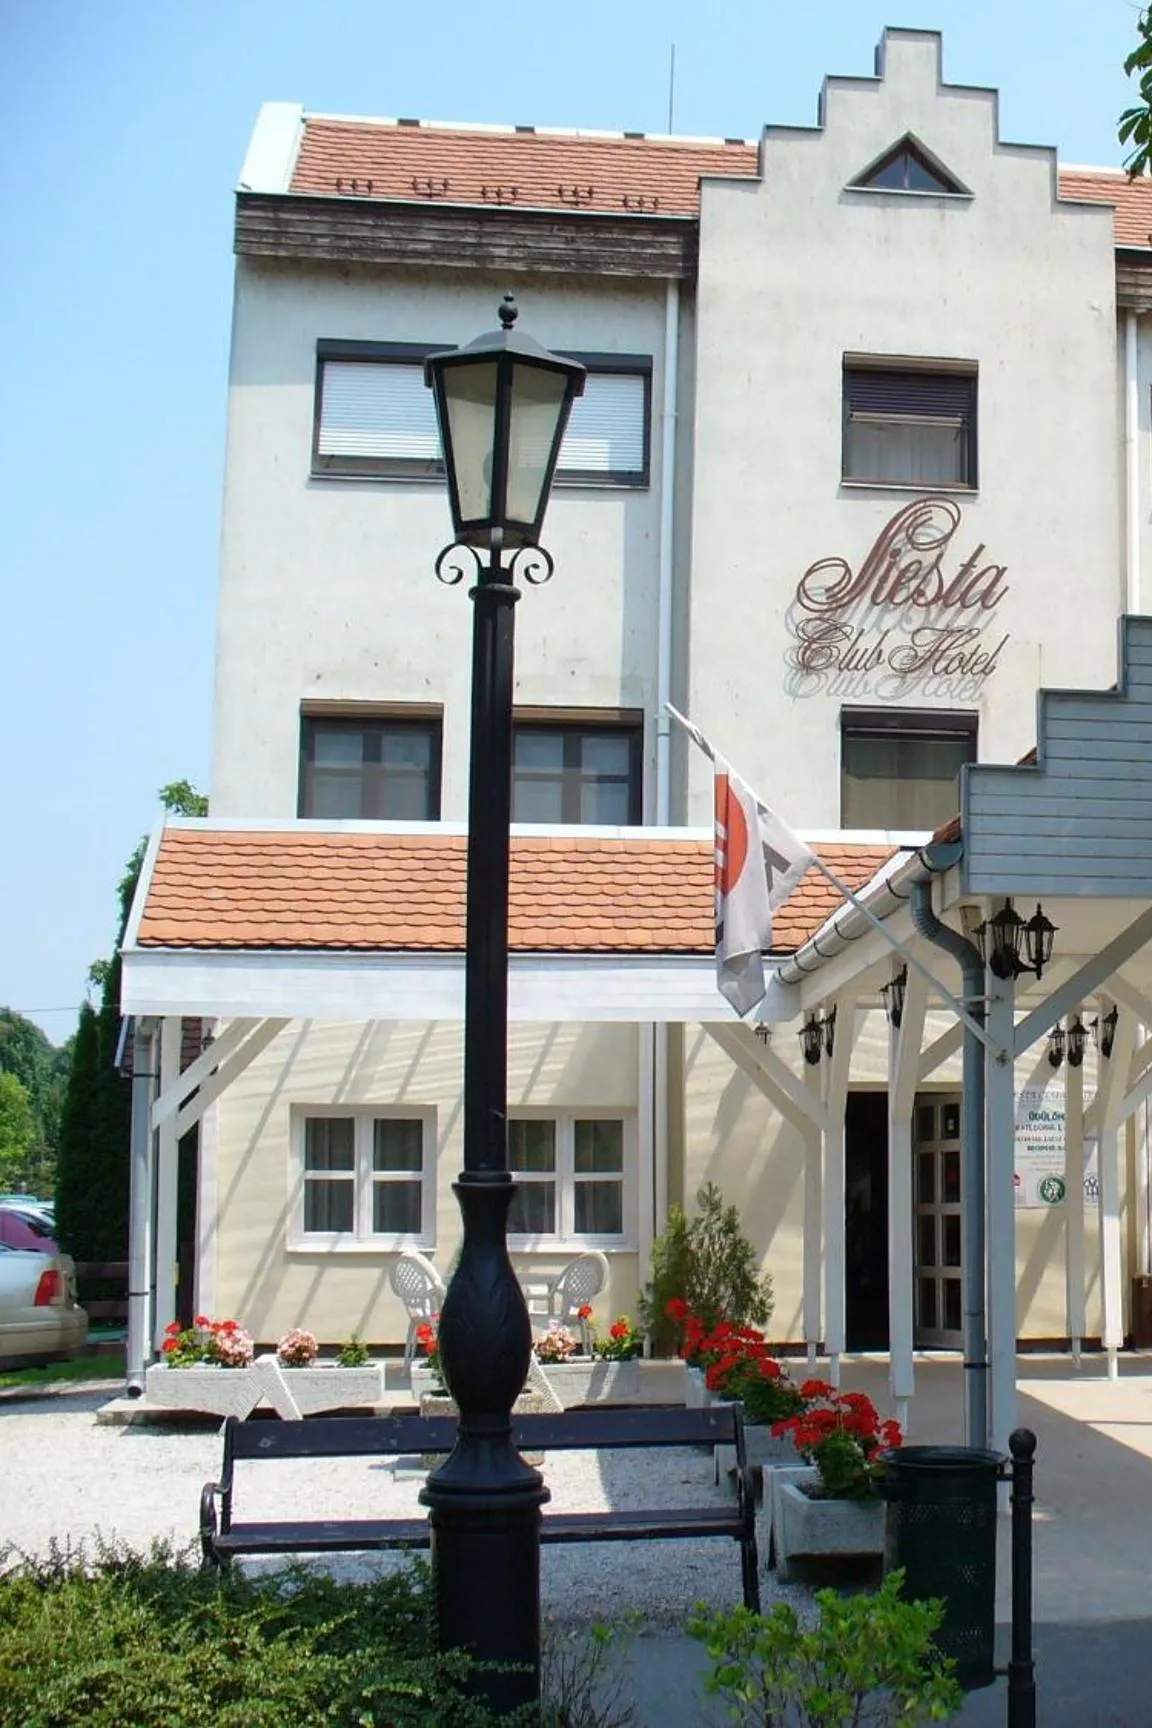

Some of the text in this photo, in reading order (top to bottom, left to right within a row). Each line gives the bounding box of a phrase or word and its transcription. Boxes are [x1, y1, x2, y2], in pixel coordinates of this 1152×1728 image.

[797, 496, 1009, 613] Siesta
[795, 617, 1010, 676] Club Hotel
